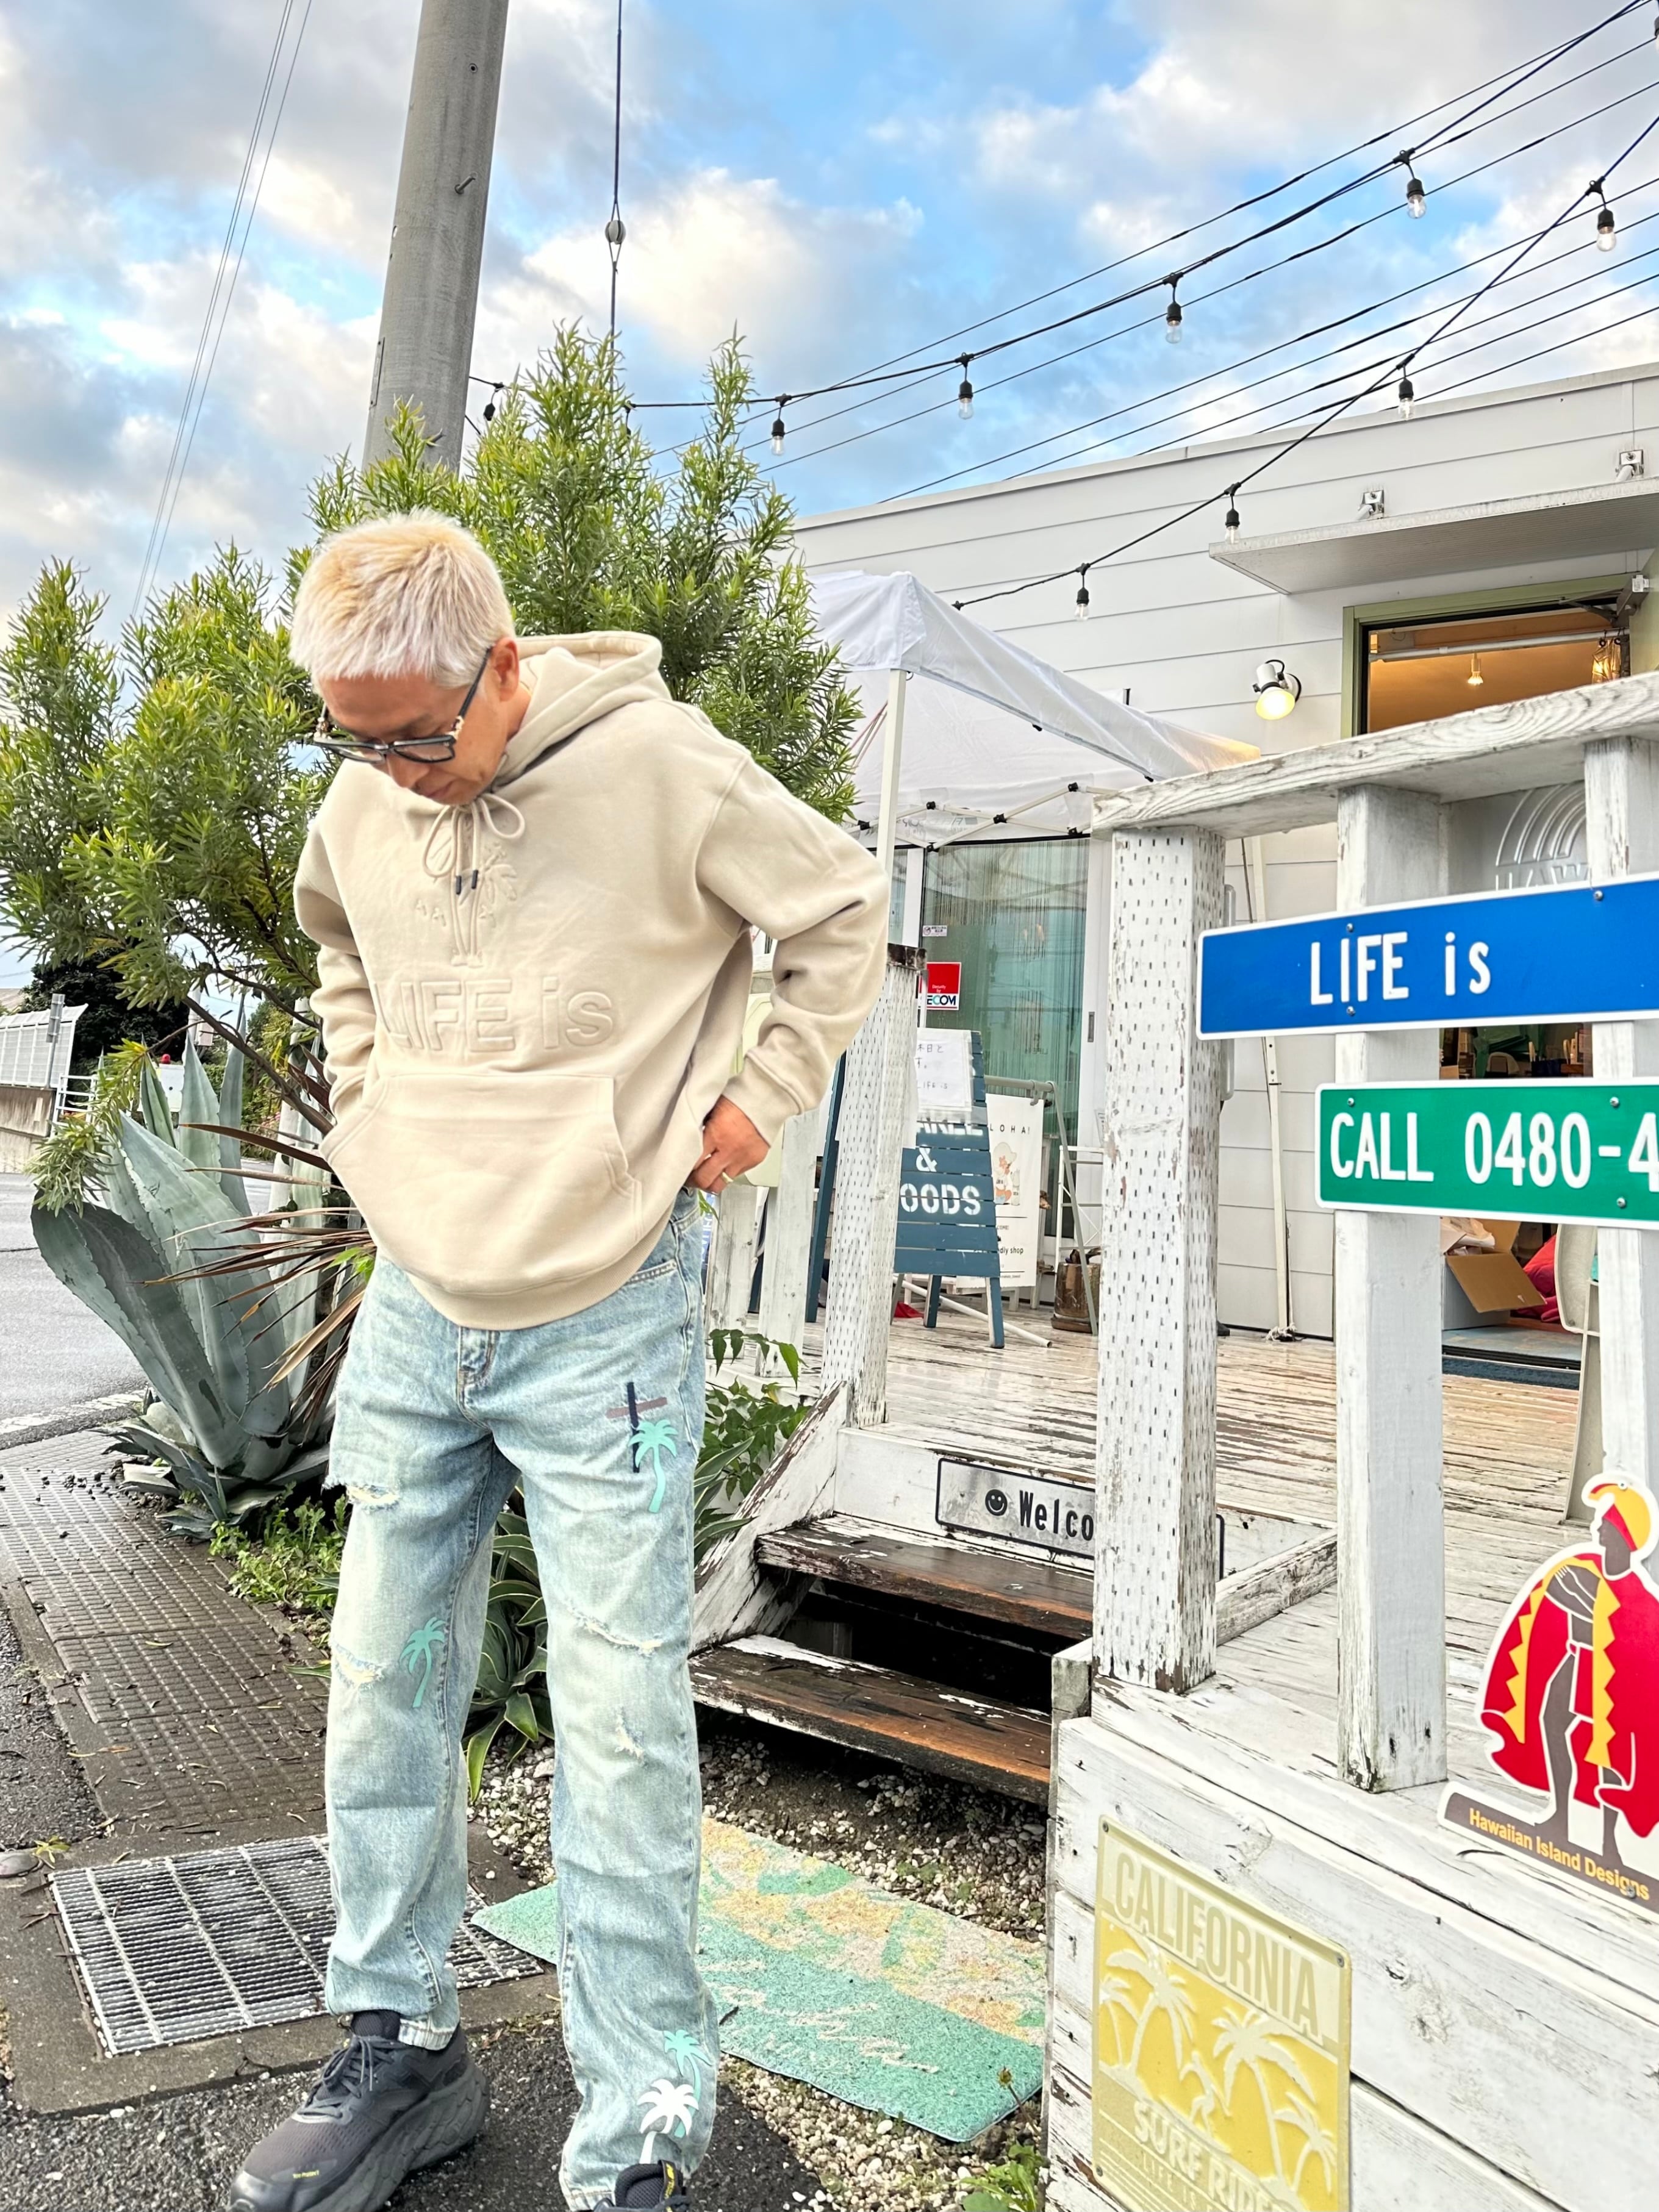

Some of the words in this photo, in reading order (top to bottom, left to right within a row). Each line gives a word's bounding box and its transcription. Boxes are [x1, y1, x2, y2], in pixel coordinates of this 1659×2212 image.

[1310, 931, 1410, 1006] LIFE
[1445, 931, 1492, 997] is
[374, 978, 517, 1053] LIFE
[541, 976, 614, 1050] is
[927, 995, 956, 1005] ECOM
[990, 1124, 1030, 1134] LOHA!
[1330, 1112, 1434, 1183] CALL
[1464, 1112, 1659, 1194] 0480-4
[916, 1144, 937, 1172] &
[900, 1183, 981, 1215] OODS
[1010, 1247, 1023, 1255] shop
[1019, 1490, 1094, 1542] Welco
[1469, 1807, 1533, 1851] Hawaiian
[1536, 1836, 1582, 1872] Island
[1584, 1856, 1650, 1901] Designs
[1114, 1853, 1320, 2038] CALIFORNIA
[1133, 2100, 1203, 2180] SURF
[1208, 2157, 1285, 2212] RIDE
[1143, 2153, 1173, 2192] LIFE
